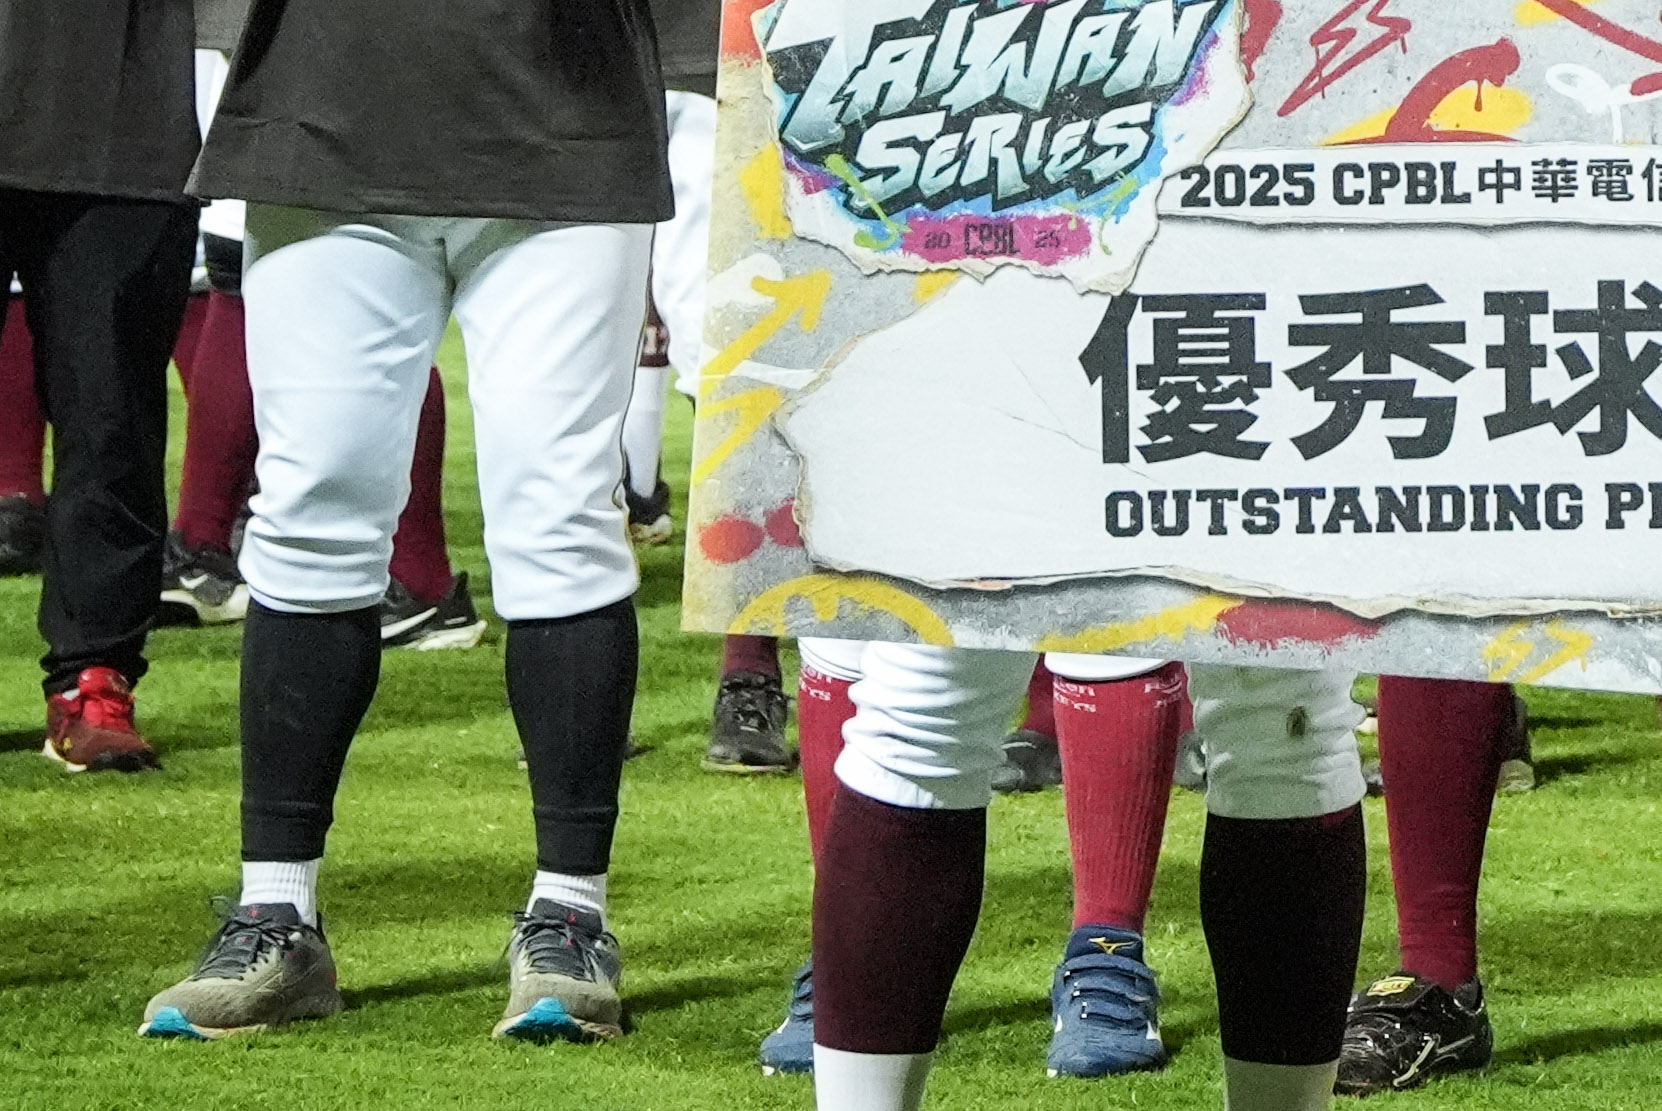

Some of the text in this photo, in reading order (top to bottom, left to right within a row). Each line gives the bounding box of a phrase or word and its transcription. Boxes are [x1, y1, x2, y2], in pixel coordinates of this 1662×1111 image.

[846, 99, 1155, 210] SERIES
[1180, 163, 1315, 207] 2025
[964, 223, 1021, 256] CPBL
[1104, 484, 1584, 538] OUTSTANDING
